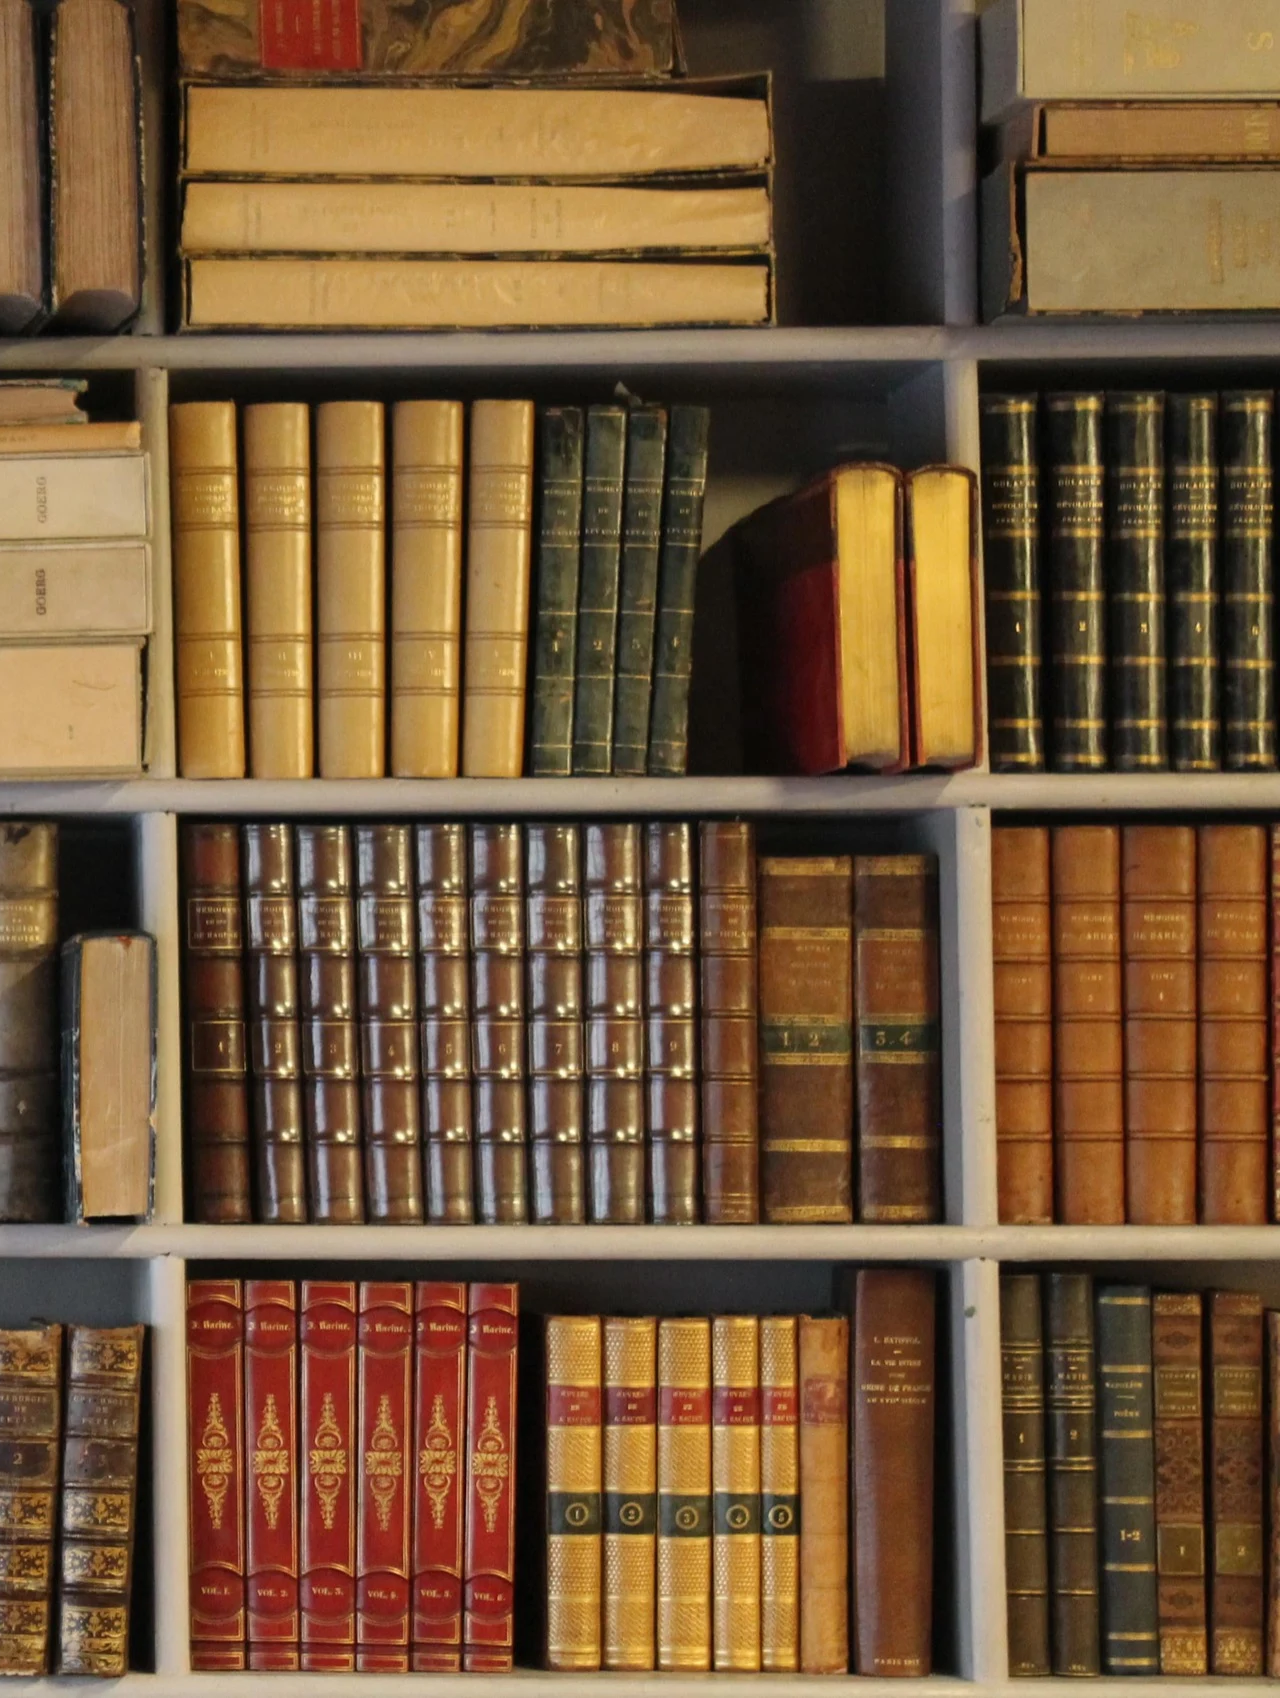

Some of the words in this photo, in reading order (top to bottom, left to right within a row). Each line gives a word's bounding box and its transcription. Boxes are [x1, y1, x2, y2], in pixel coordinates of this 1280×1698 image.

[36, 476, 47, 524] GOERG
[36, 568, 47, 616] GOERG
[274, 1042, 282, 1054] 2
[330, 1043, 337, 1055] 3
[387, 1045, 395, 1057] 4
[445, 1043, 453, 1055] 5
[498, 1043, 506, 1055] 6
[555, 1043, 562, 1055] 7
[612, 1042, 620, 1053] 8
[670, 1041, 677, 1052] 9
[1070, 1430, 1077, 1440] 2
[13, 1453, 22, 1465] 2
[1120, 1530, 1141, 1541] 1-2
[1238, 1546, 1245, 1556] 2
